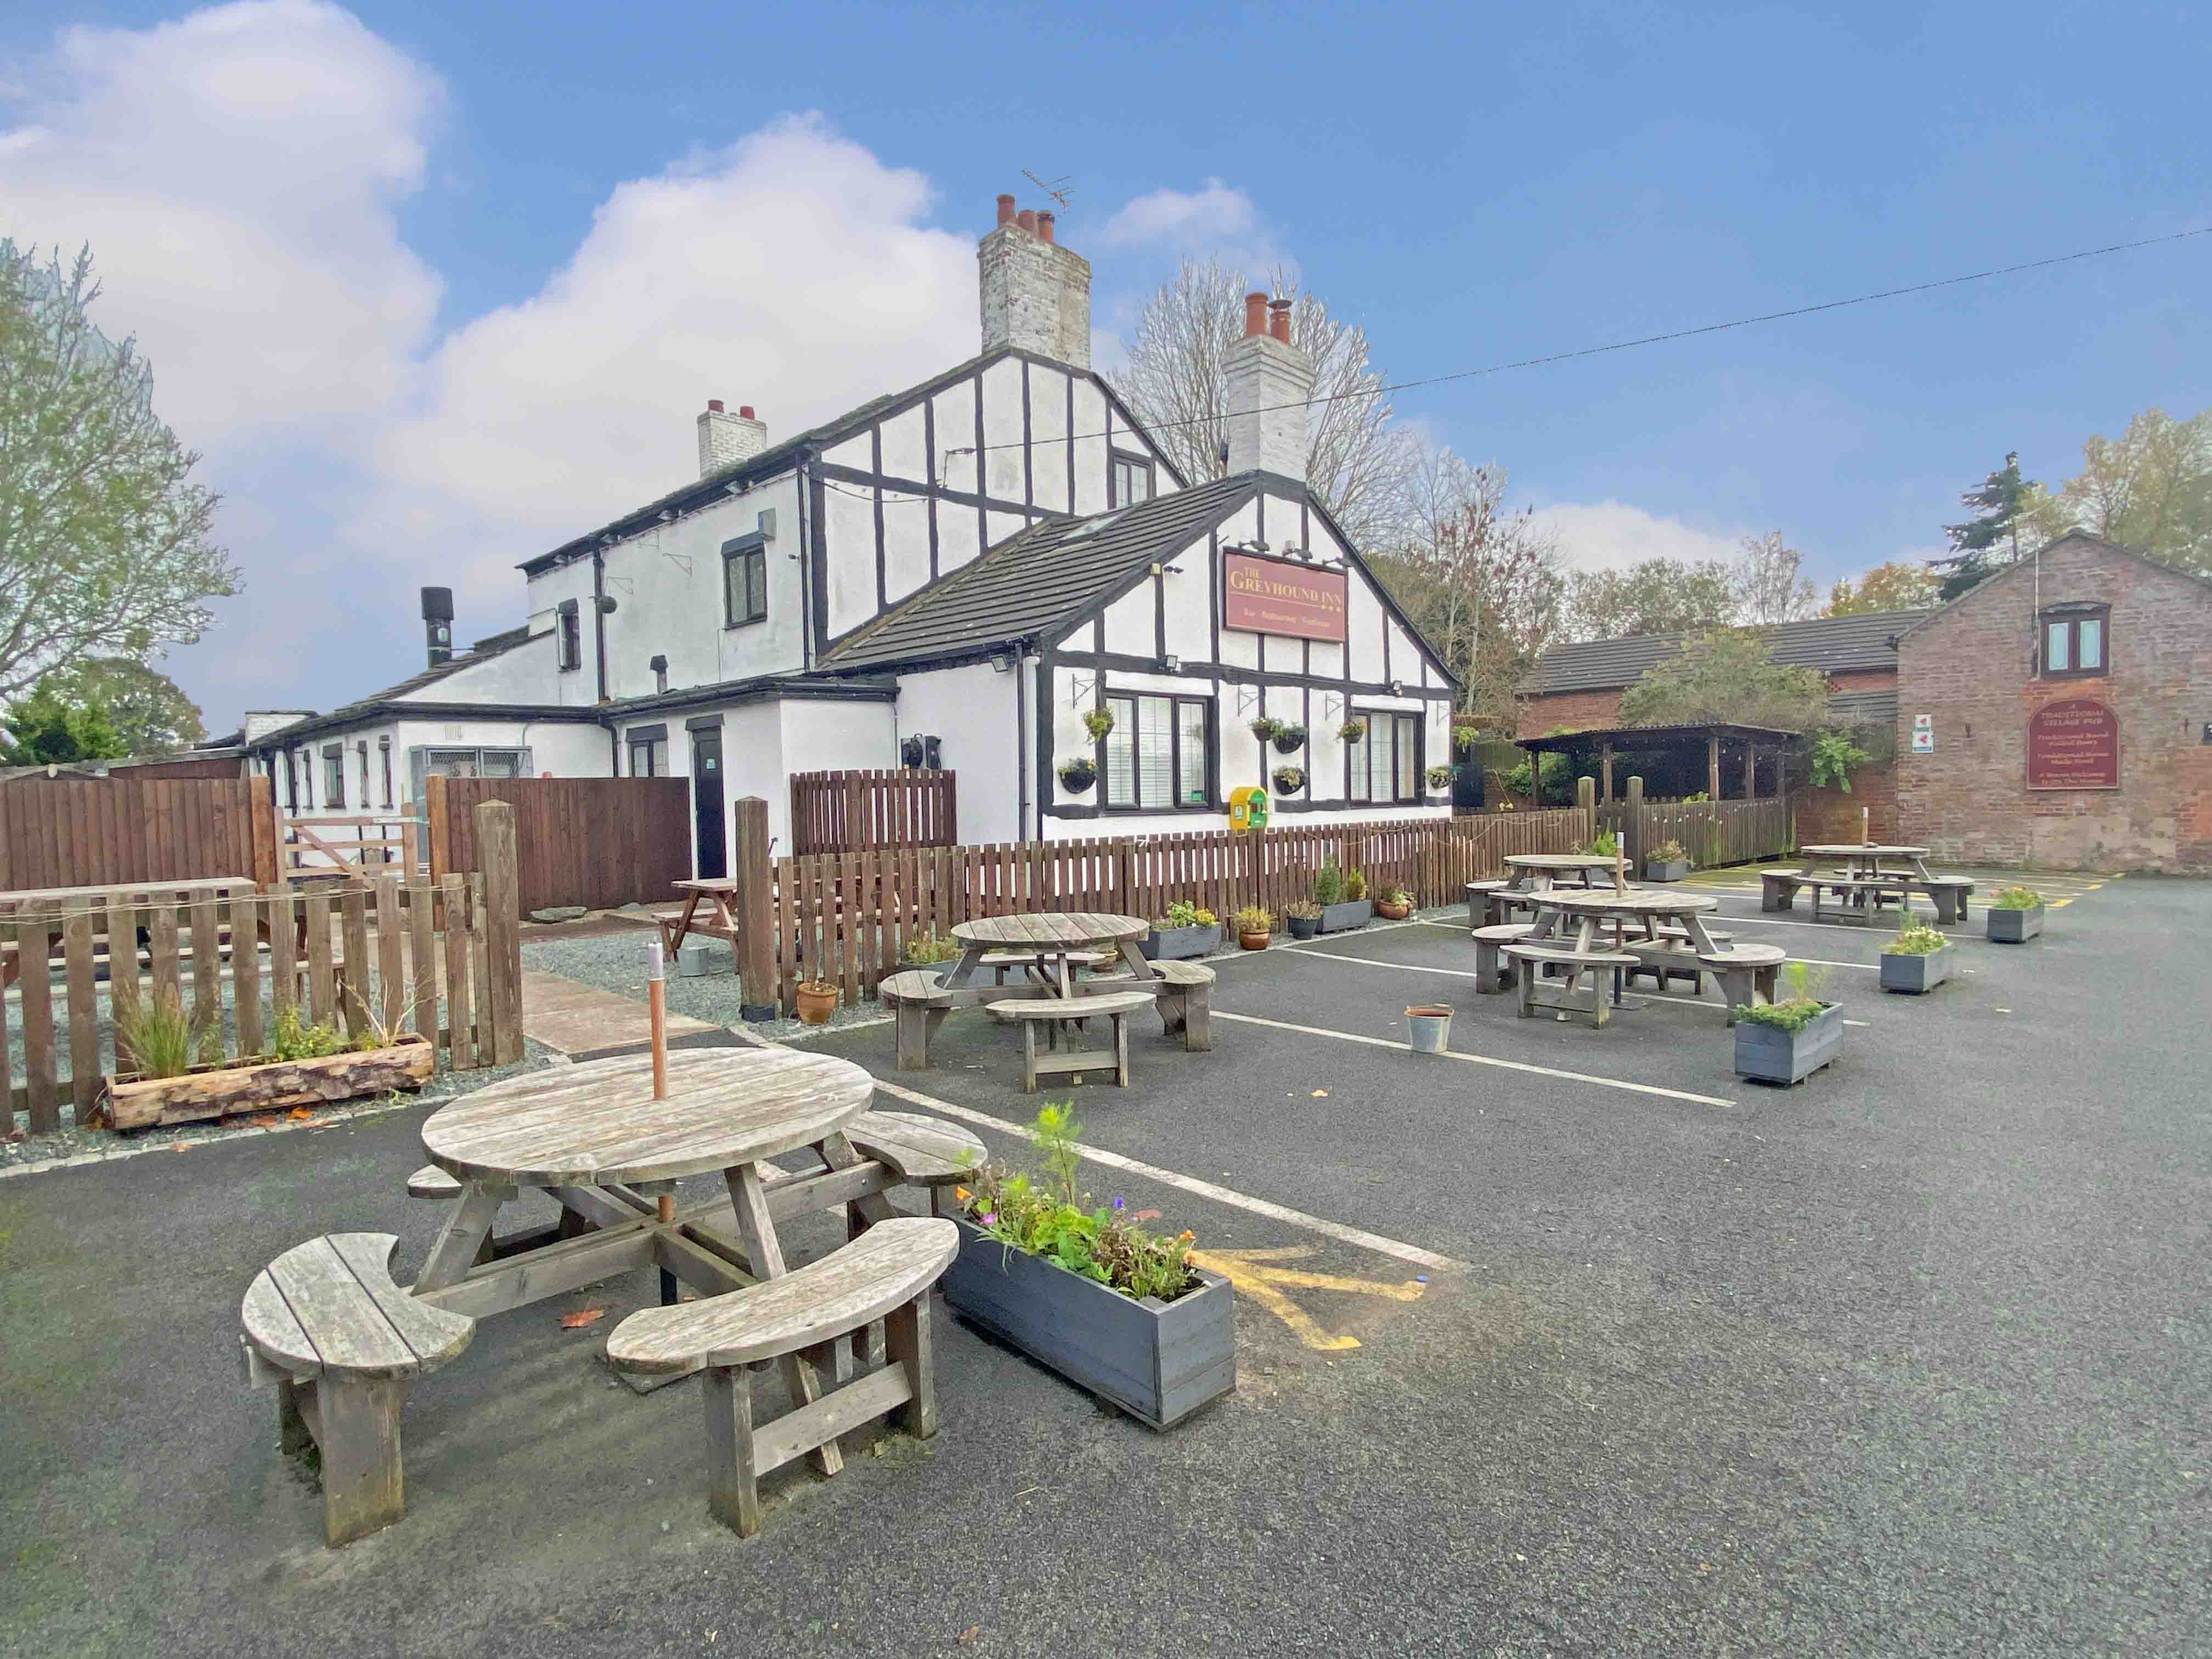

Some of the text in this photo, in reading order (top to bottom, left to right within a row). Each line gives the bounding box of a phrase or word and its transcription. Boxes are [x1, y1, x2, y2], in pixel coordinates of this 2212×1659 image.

[1244, 567, 1260, 578] THE
[1229, 571, 1342, 606] GREYHOUND INN
